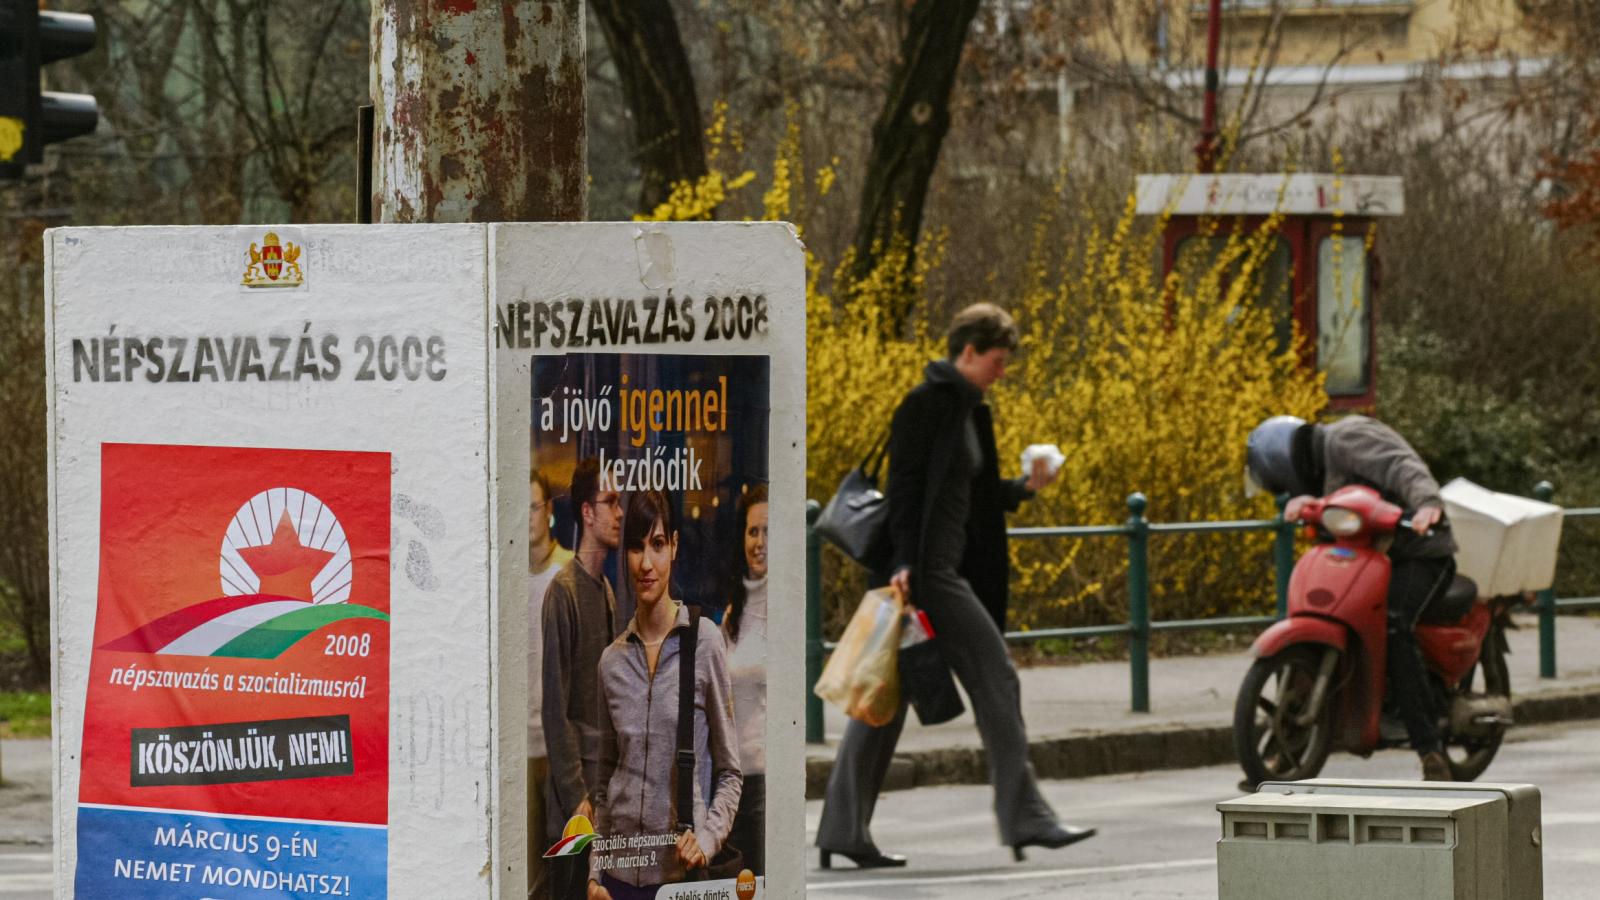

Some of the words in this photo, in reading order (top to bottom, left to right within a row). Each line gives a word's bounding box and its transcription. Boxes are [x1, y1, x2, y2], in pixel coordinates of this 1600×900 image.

[703, 295, 770, 341] 2008
[72, 322, 342, 383] NÉPSZAVAZÁS
[353, 334, 448, 382] 2008
[541, 397, 553, 431] a
[560, 385, 613, 443] jövő
[619, 374, 727, 447] igennel
[600, 446, 702, 491] kezdődik
[324, 633, 371, 657] 2008
[109, 664, 219, 691] népszavazás
[223, 676, 234, 692] a
[238, 671, 367, 699] szocializmusról
[138, 728, 284, 775] KÖSZÖNJÜK,
[288, 730, 348, 767] NEM!
[154, 822, 259, 854] MÁRCIUS
[266, 831, 318, 862] 9-ÉN
[592, 834, 627, 852] szociális
[627, 830, 678, 851] népszavazás
[616, 852, 649, 869] március
[650, 851, 658, 866] 9.
[114, 858, 196, 883] NEMET
[201, 865, 350, 897] MONDHATSZ!
